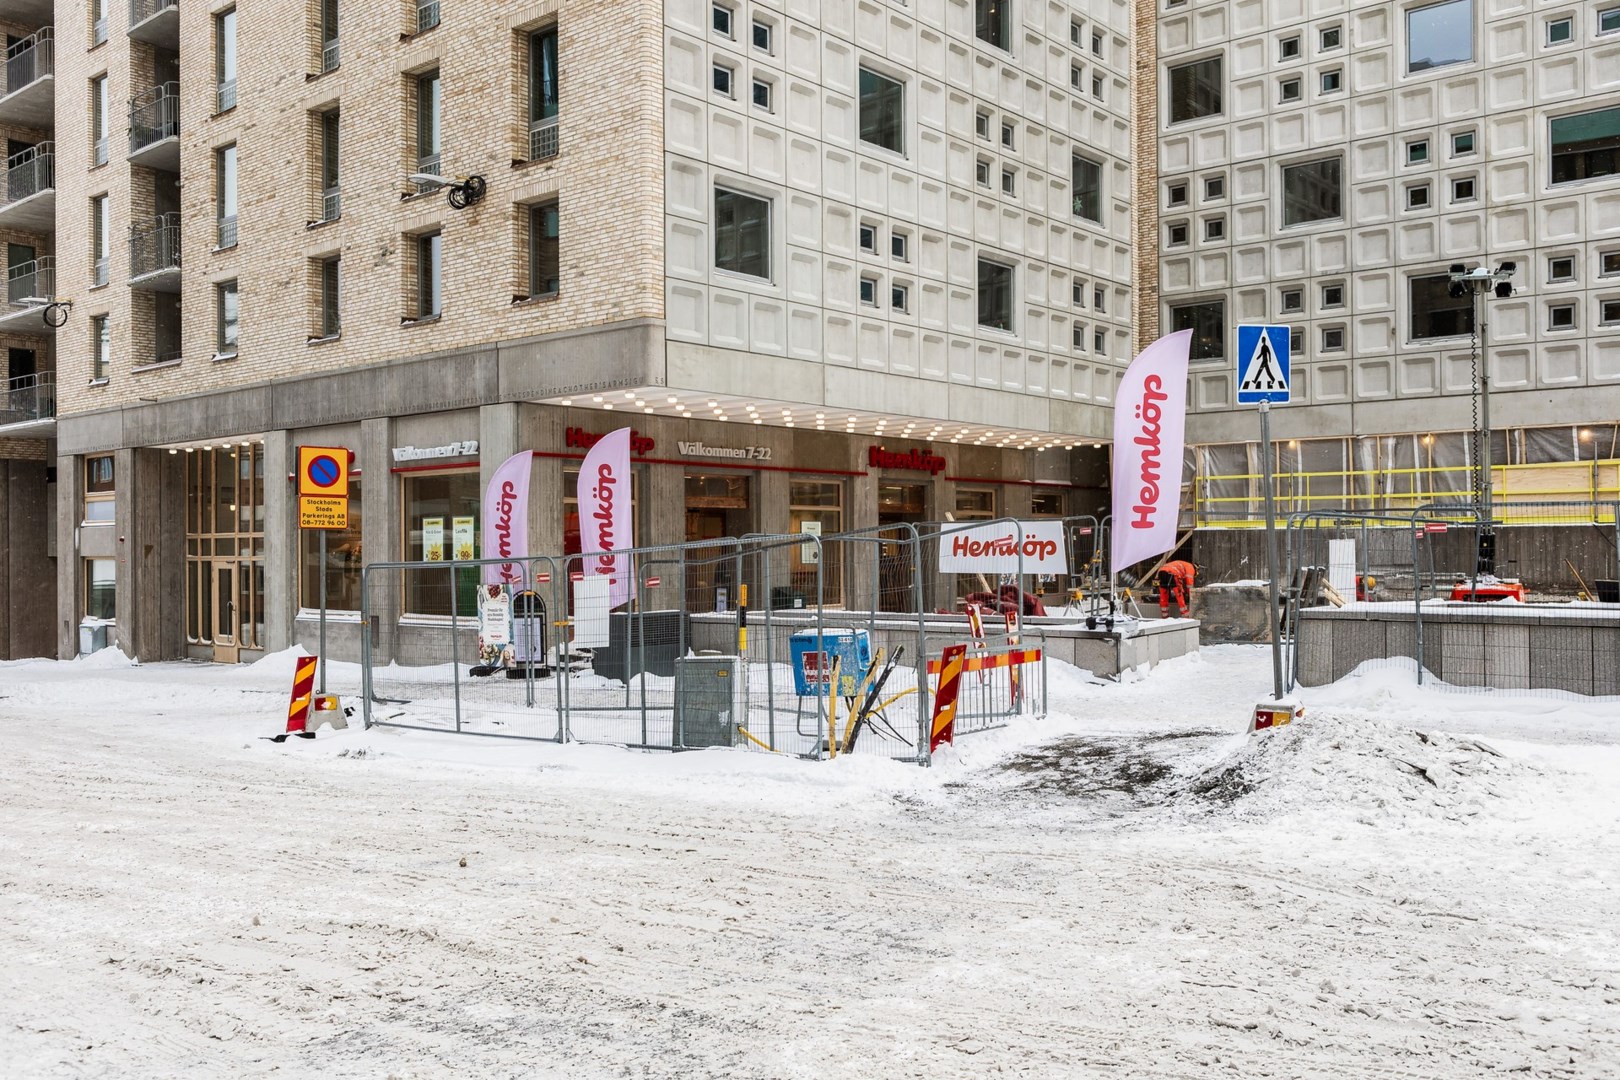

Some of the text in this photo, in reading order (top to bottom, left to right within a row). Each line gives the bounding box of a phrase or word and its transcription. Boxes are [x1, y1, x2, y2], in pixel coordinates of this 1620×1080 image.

[677, 441, 772, 460] Välkommen 7-22
[1131, 374, 1168, 529] Hemköp
